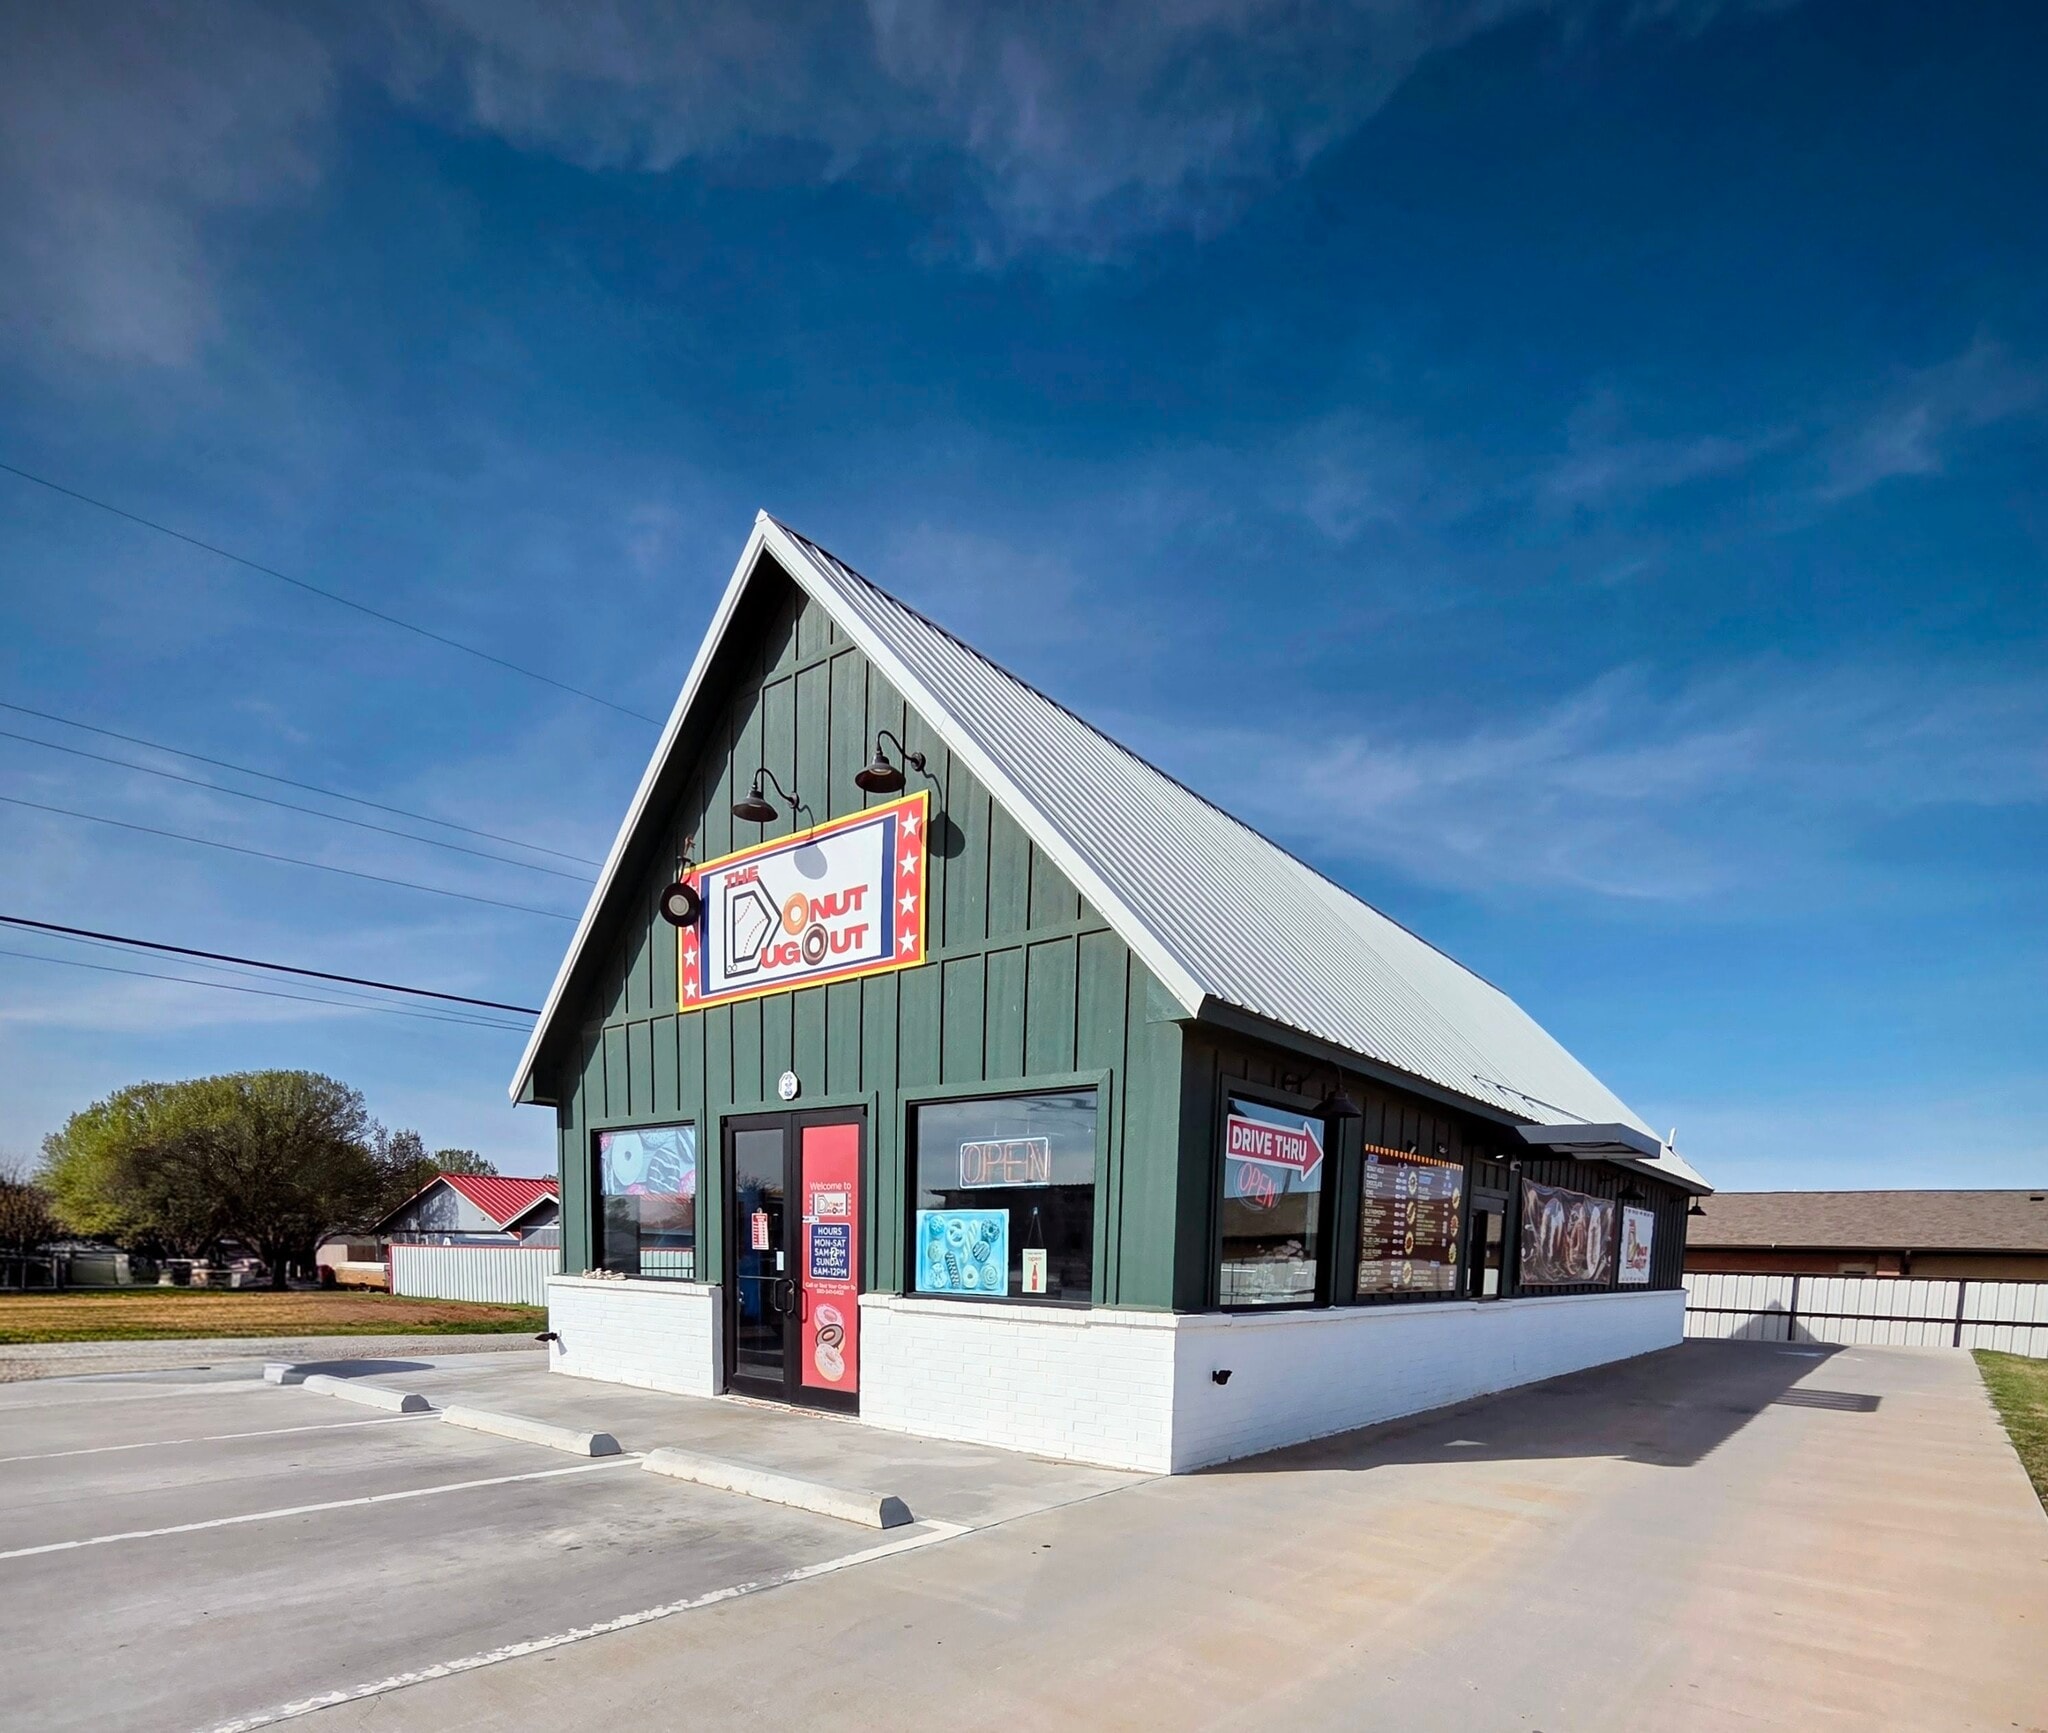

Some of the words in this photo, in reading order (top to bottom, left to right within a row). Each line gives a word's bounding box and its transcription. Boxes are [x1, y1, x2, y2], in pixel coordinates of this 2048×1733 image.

[724, 865, 759, 889] THE
[1232, 1125, 1273, 1156] DRIVE
[1275, 1134, 1307, 1162] THRU
[963, 1141, 1047, 1184] OPEN
[809, 1181, 842, 1190] Welcome
[843, 1181, 851, 1190] to
[1239, 1162, 1276, 1208] OPEN
[817, 1227, 842, 1235] HOURS
[814, 1239, 846, 1247] MON-SAT
[814, 1247, 846, 1258] 5AM-2PM
[815, 1258, 844, 1266] SUNDAY
[813, 1267, 847, 1276] 6AM-12PM
